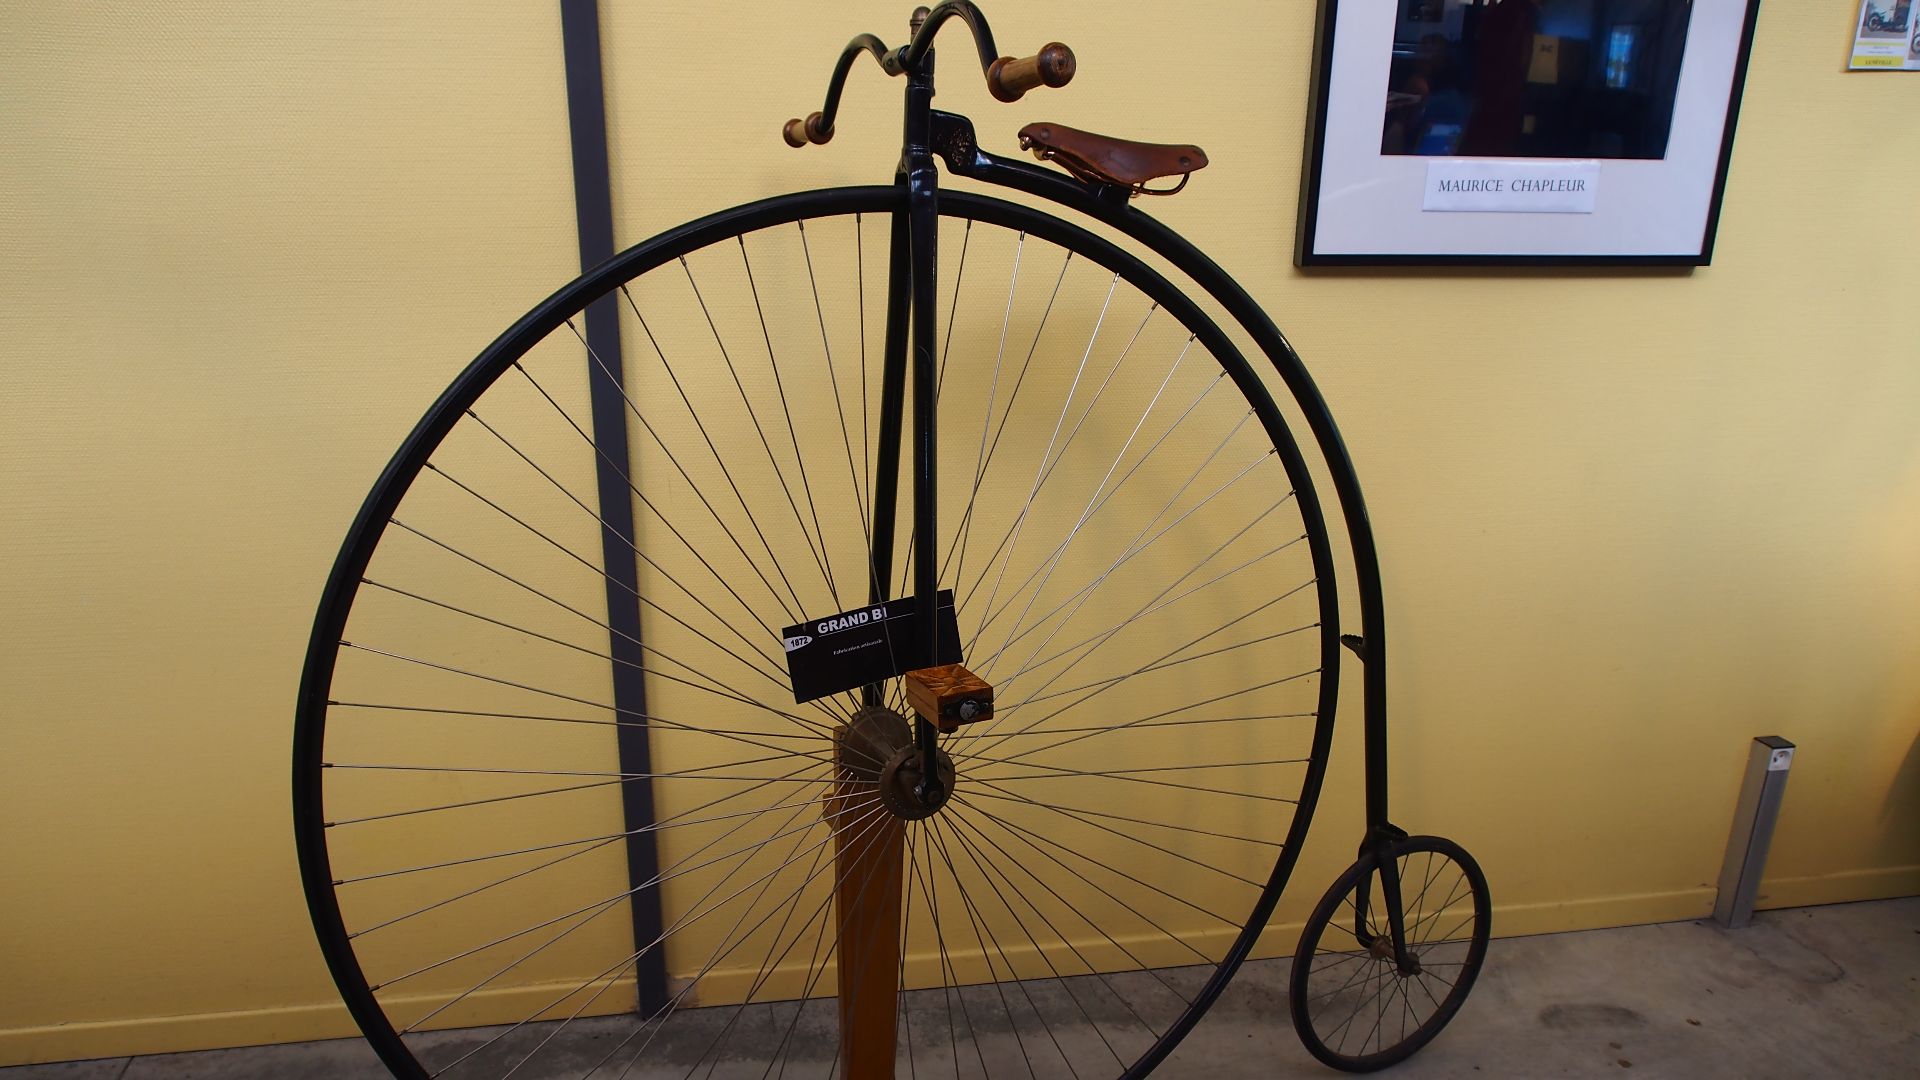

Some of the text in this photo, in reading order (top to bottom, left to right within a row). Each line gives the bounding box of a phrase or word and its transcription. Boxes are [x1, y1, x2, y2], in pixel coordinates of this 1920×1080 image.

[1438, 179, 1585, 192] MAURICE CHAPLEUR
[817, 607, 888, 634] GRAND BI
[790, 636, 808, 648] 1872
